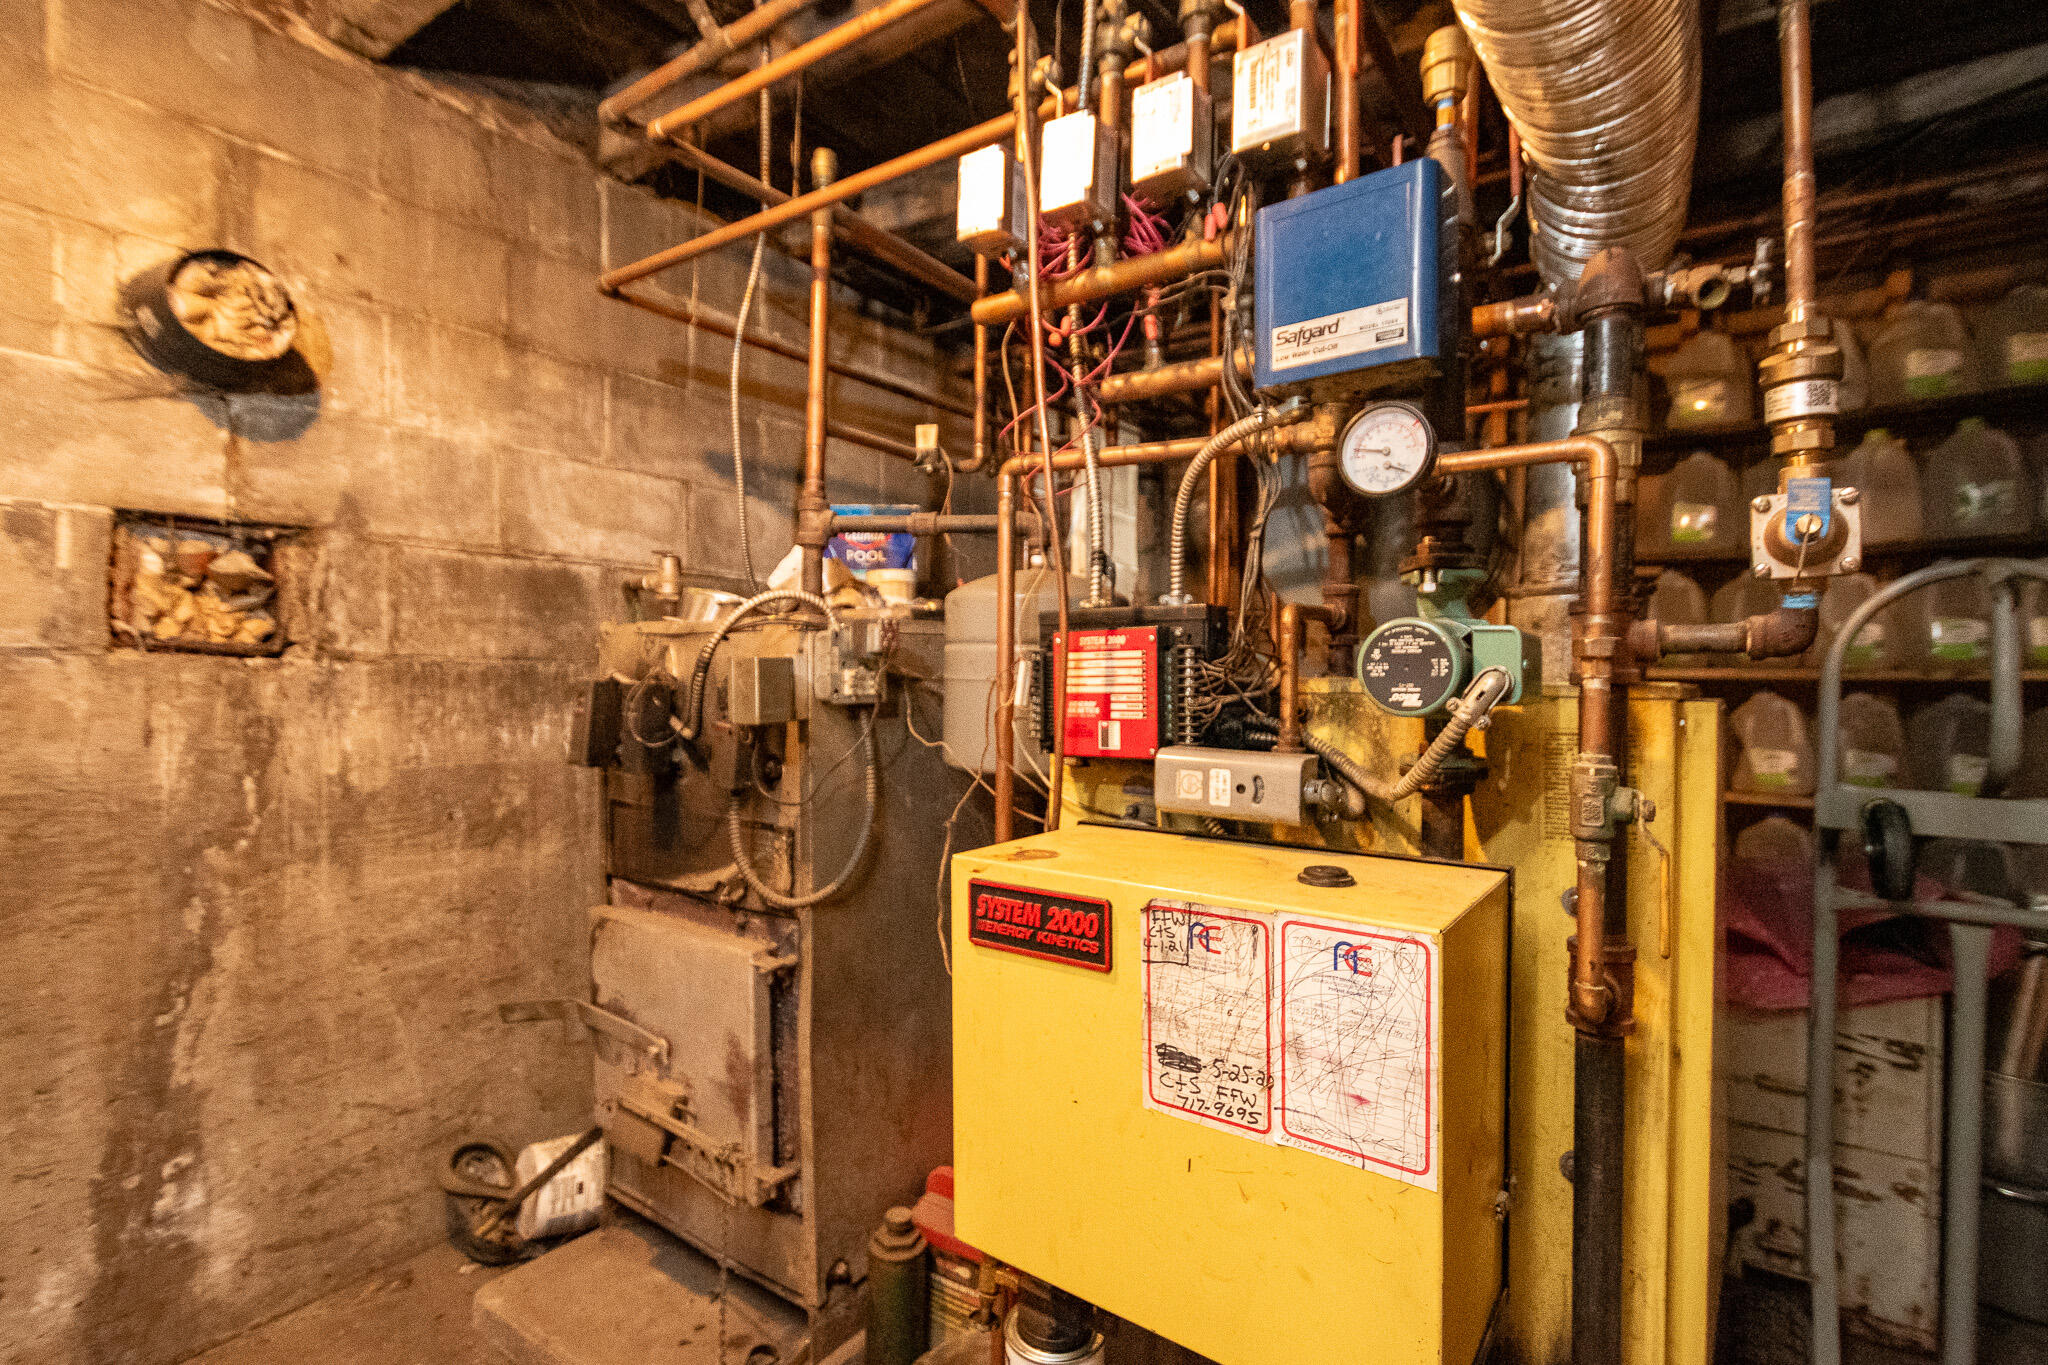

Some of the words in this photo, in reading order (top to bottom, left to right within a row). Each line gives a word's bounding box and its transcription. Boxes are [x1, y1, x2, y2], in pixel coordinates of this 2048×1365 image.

[1276, 317, 1340, 347] Safgard
[846, 548, 887, 563] POOL
[976, 893, 1042, 928] SYSTEM
[1045, 906, 1100, 939] 2000
[985, 919, 1034, 941] ENERGY
[1036, 931, 1100, 954] KINETICS
[1177, 1094, 1263, 1125] 717-9695
